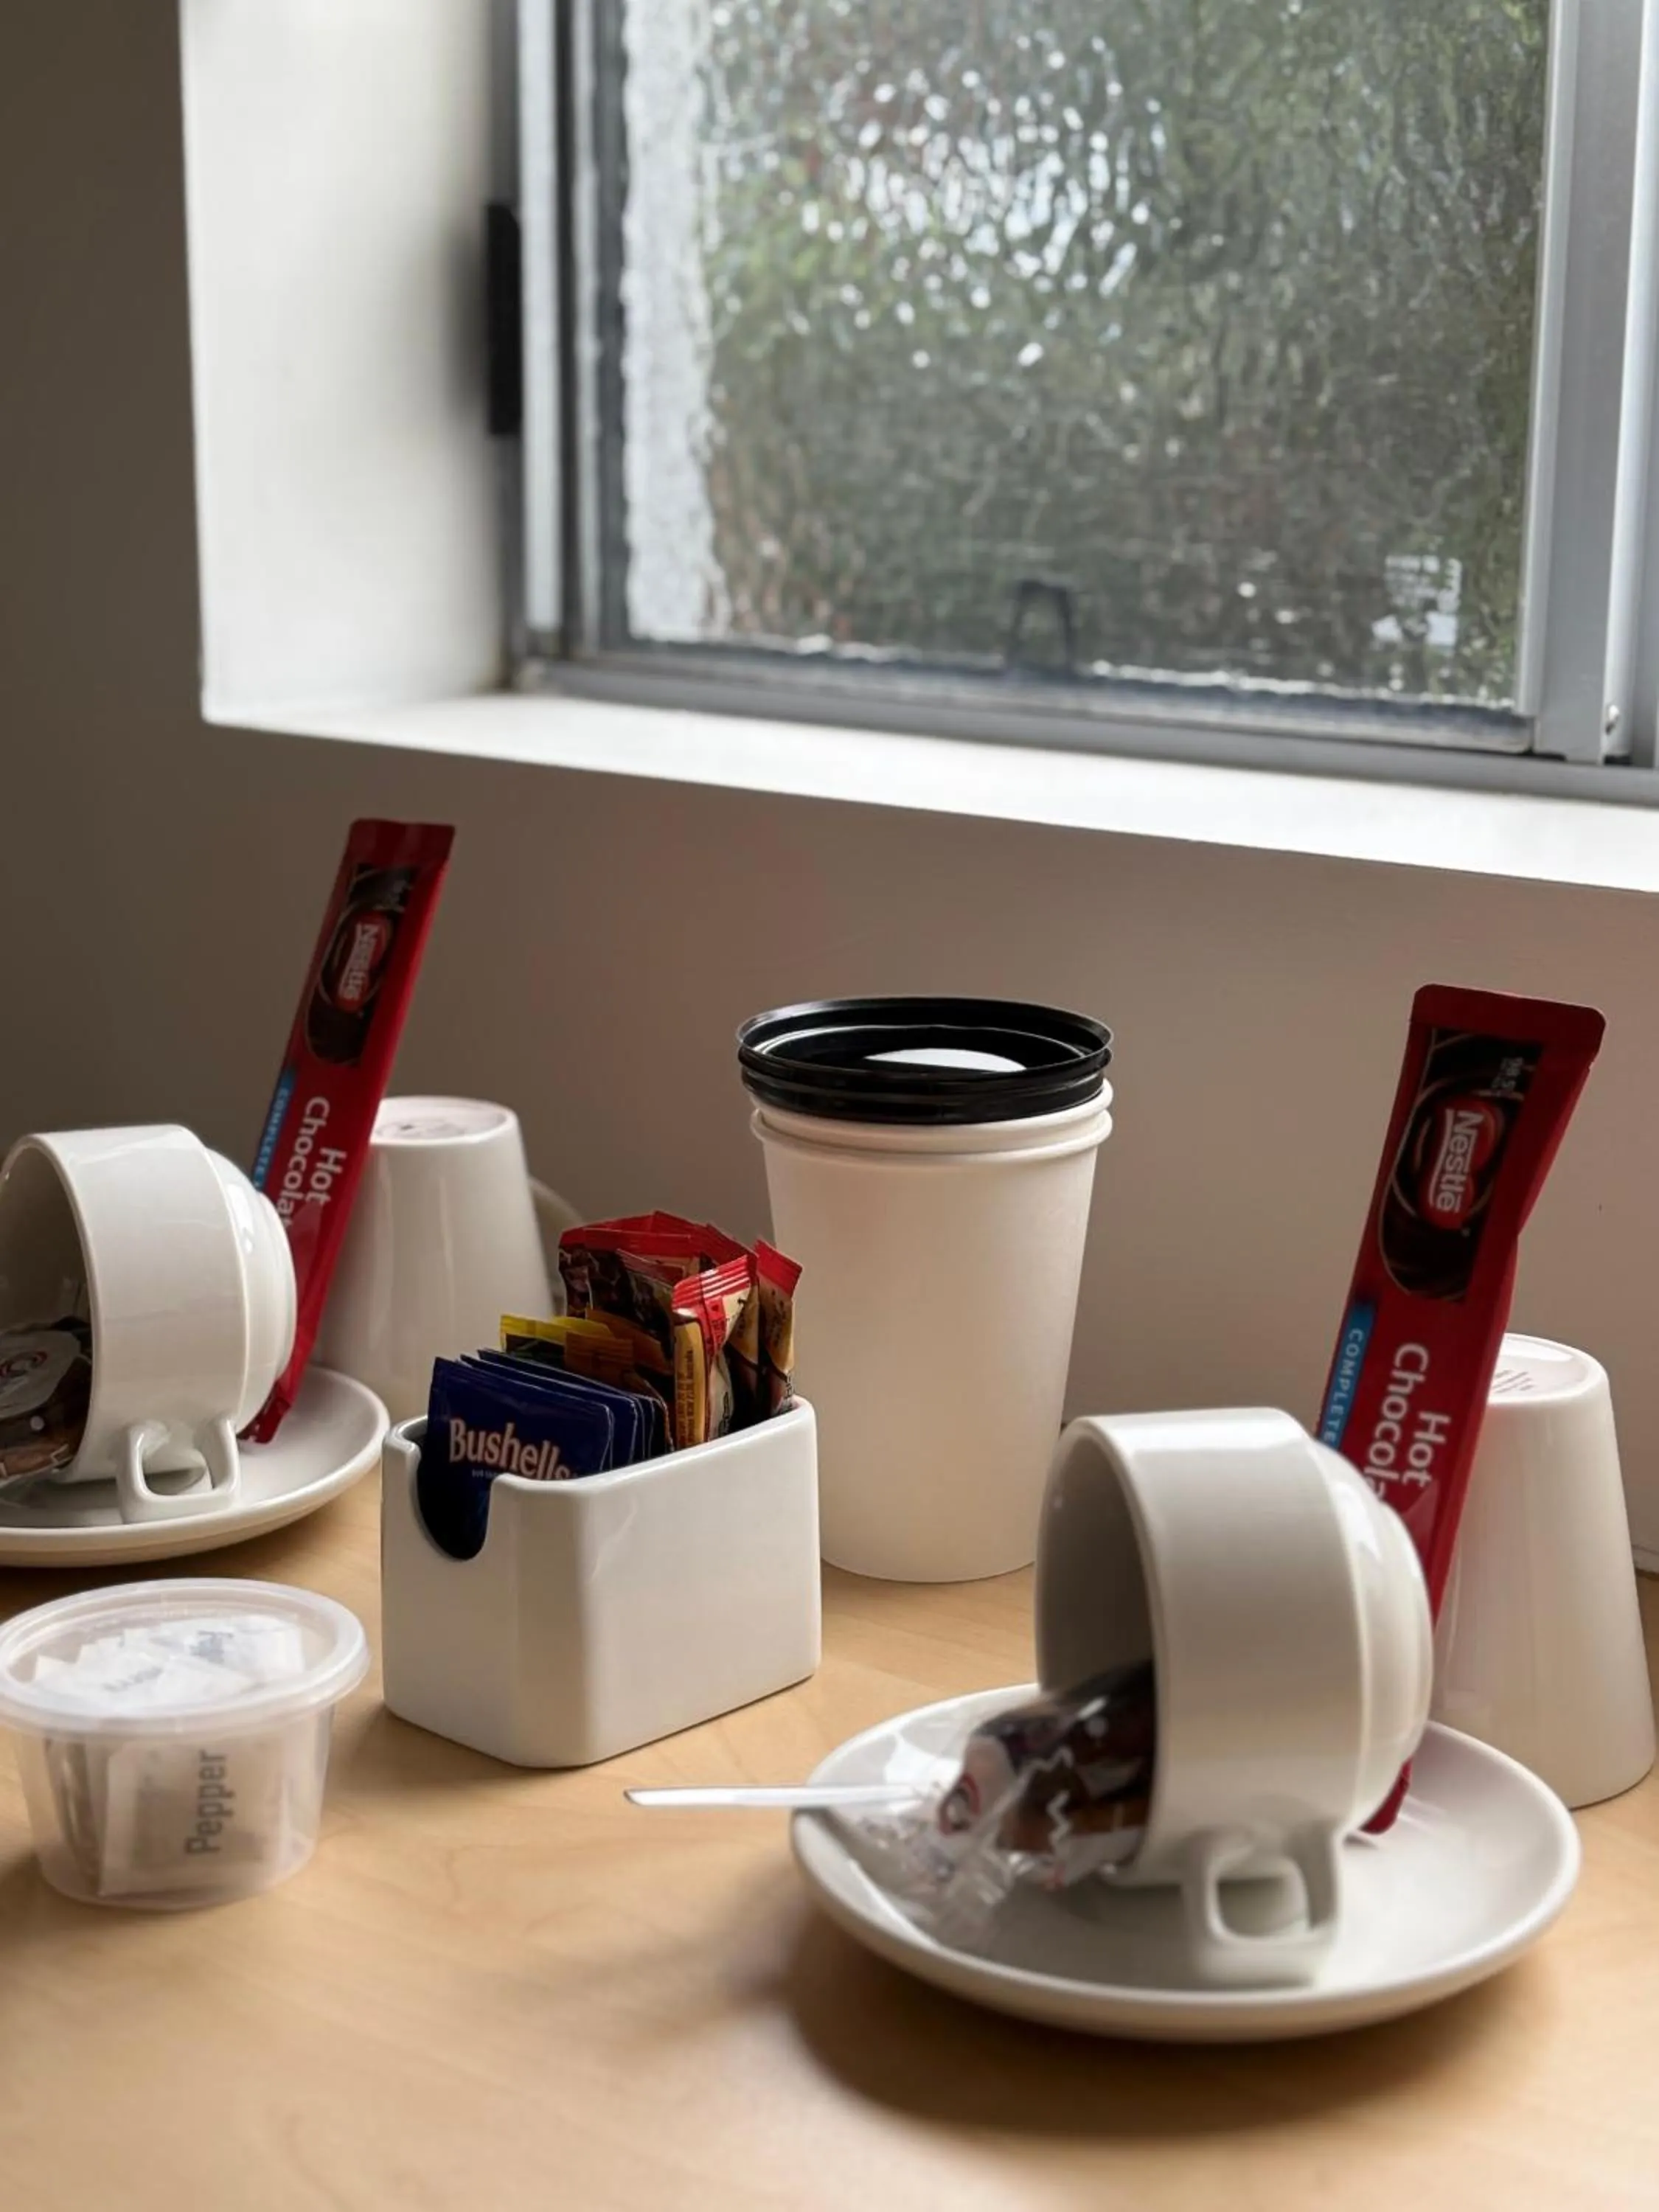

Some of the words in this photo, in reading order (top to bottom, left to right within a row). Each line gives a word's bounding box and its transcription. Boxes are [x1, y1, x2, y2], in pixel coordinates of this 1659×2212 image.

[305, 1147, 347, 1205] Hot
[1324, 1328, 1363, 1442] COMPLETE
[1402, 1411, 1451, 1488] Hot
[186, 1750, 236, 1854] Pepper
